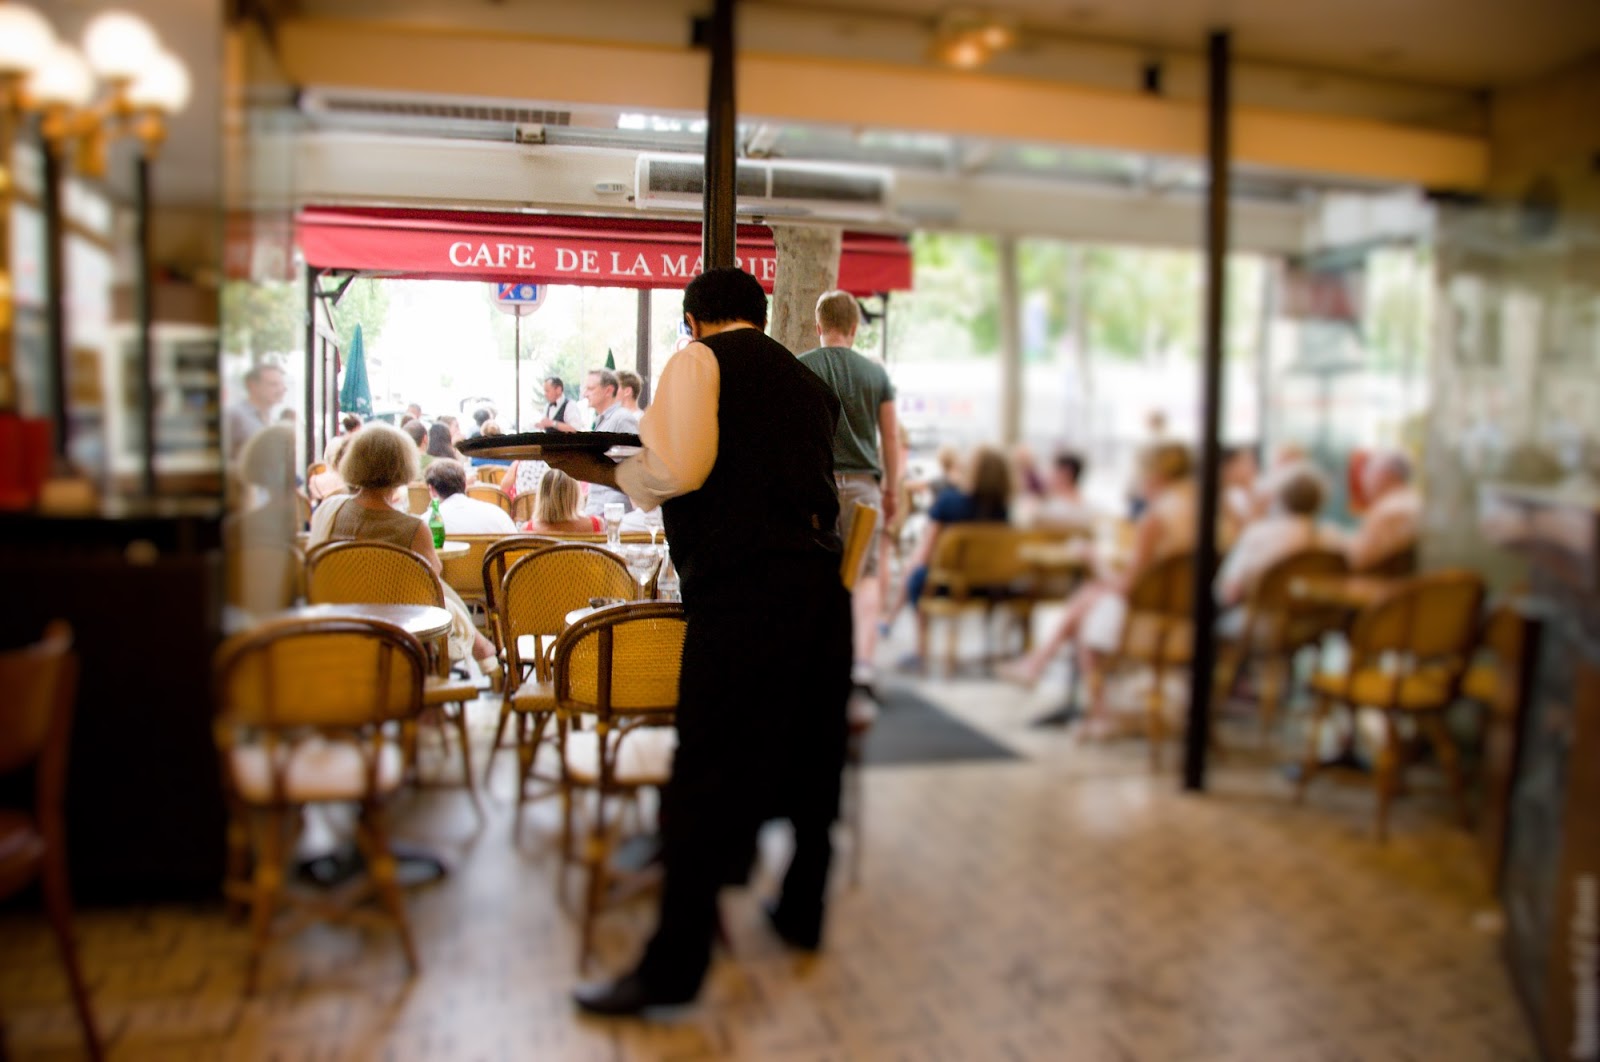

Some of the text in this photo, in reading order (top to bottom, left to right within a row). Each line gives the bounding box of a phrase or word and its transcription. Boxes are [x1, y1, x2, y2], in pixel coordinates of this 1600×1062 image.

[449, 241, 777, 281] CAFE DE LA MAIE
